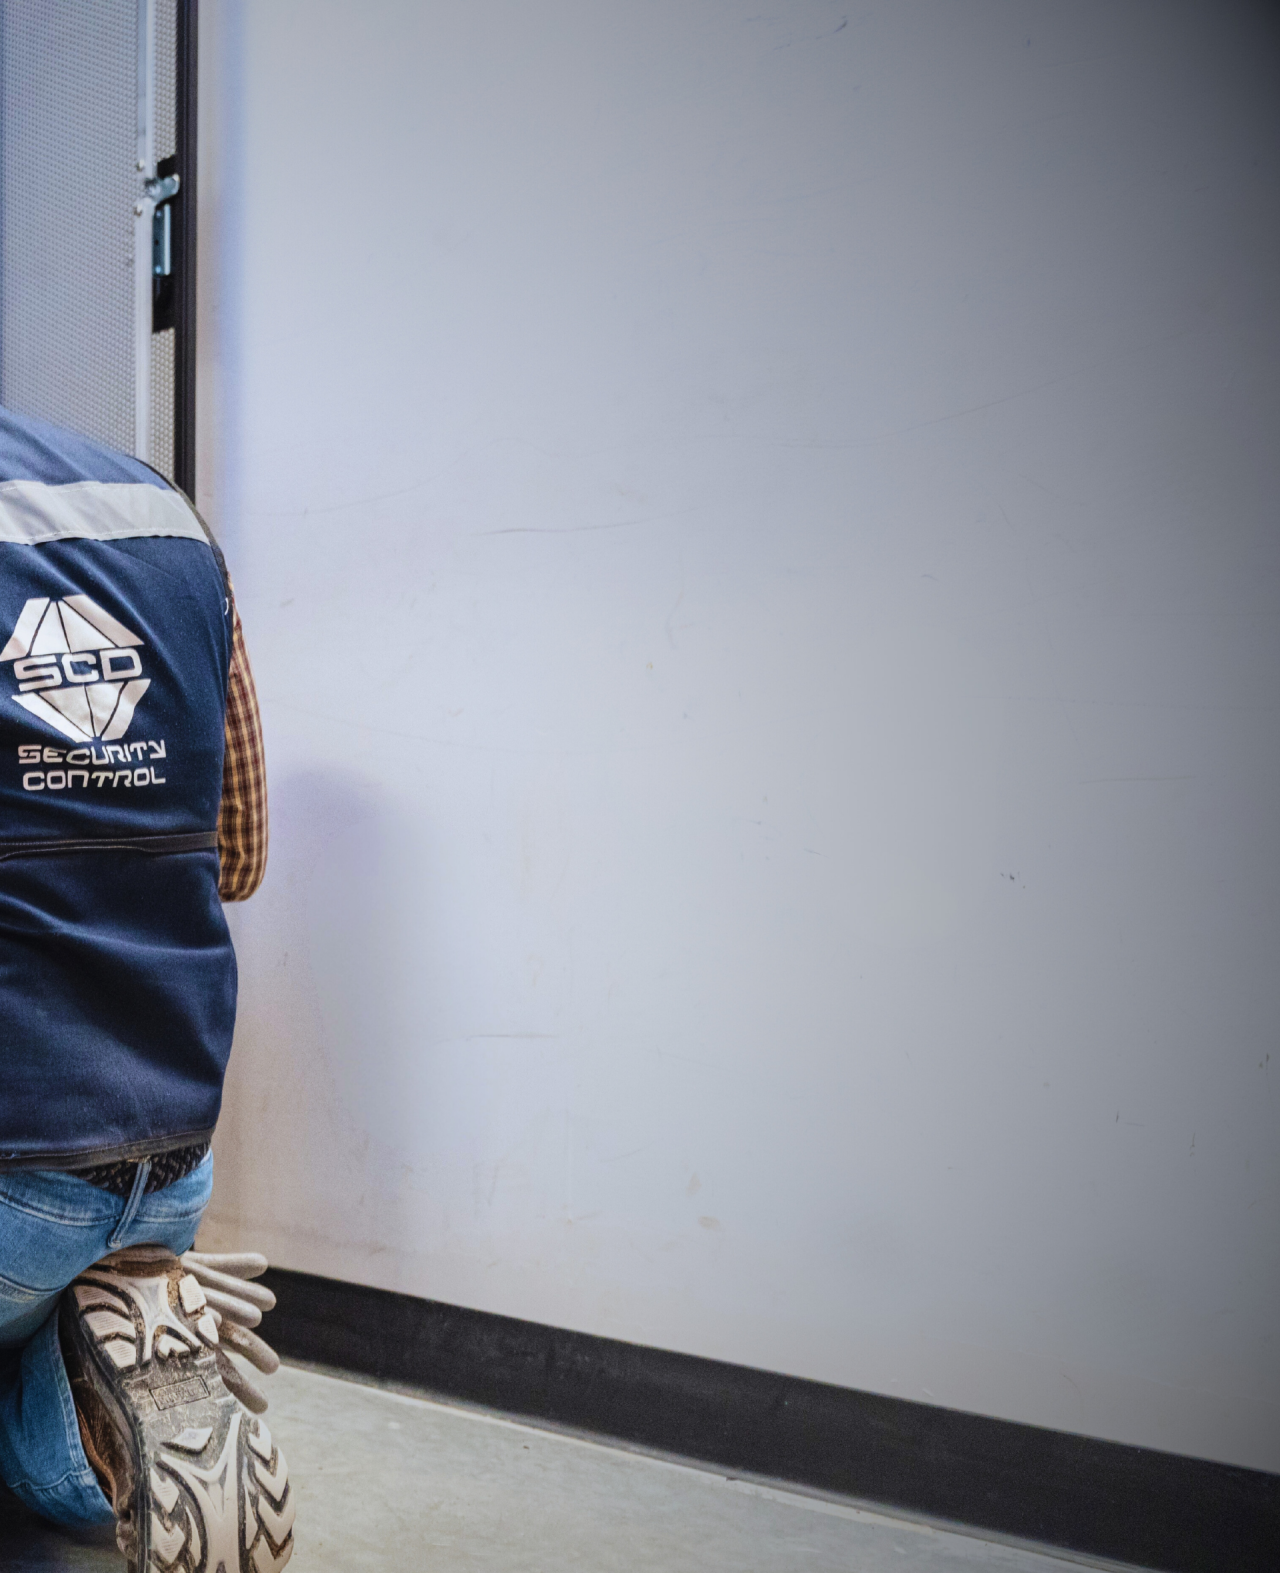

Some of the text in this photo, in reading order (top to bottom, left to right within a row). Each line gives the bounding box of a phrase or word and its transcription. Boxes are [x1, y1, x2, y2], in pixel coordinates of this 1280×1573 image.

[13, 648, 143, 692] SCD
[17, 739, 167, 766] SECURITY
[22, 766, 166, 791] CONTROL
